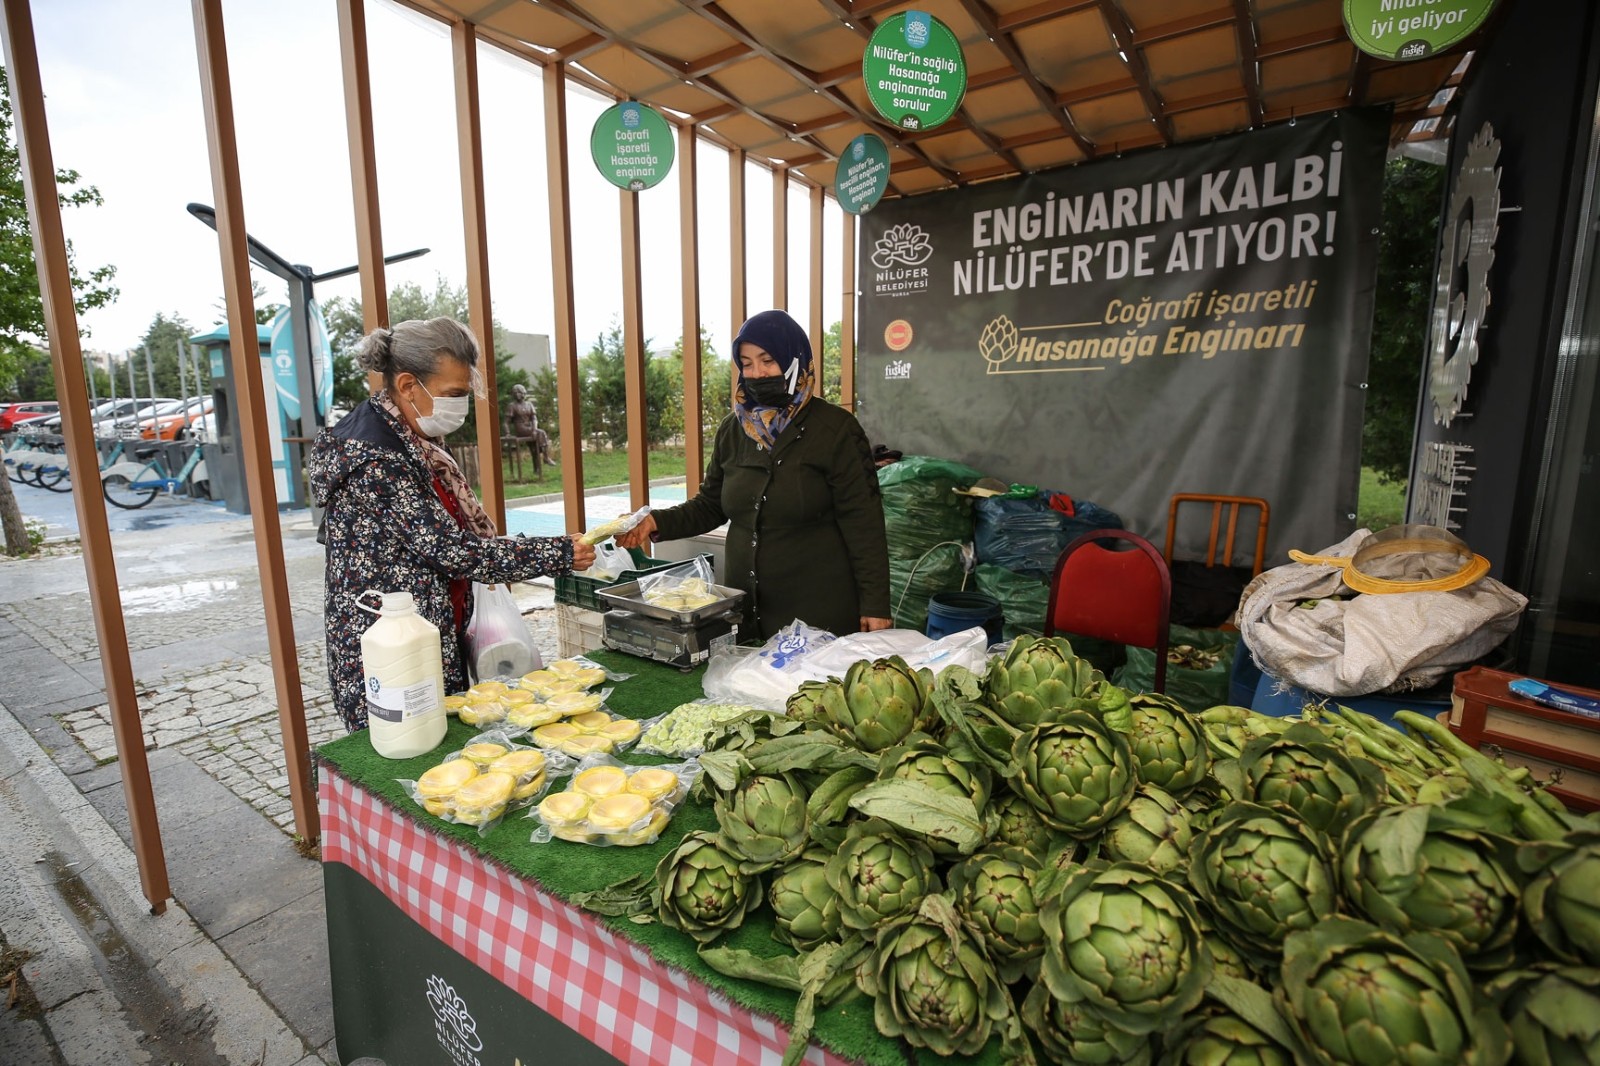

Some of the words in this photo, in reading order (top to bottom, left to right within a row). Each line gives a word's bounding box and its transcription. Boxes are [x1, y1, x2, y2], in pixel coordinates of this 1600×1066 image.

[1371, 16, 1394, 39] iyi
[1398, 8, 1468, 35] geliyor
[873, 45, 921, 65] Nilüfer'in
[922, 56, 957, 74] sağlığı
[888, 63, 940, 85] Hasanağa
[878, 79, 947, 100] enginarından
[892, 97, 931, 112] sorulur
[615, 129, 650, 142] Coğrafi
[616, 142, 650, 156] işaretli
[610, 154, 658, 167] Hasanağa
[615, 166, 655, 179] enginarı
[848, 175, 877, 196] Hasanağa
[851, 186, 876, 204] enginarı
[973, 178, 1185, 248] ENGİNARIN
[1199, 140, 1343, 216] KALBİ
[953, 235, 1156, 296] NİLÜFER'DE
[1165, 210, 1337, 273] ATIYOR!
[875, 267, 929, 282] NİLÜFER
[875, 278, 928, 292] BELEDİYESİ
[1105, 291, 1203, 328] Coğrafi
[1205, 280, 1318, 321] işaretli
[1015, 328, 1158, 364] Hasanağa
[1163, 320, 1306, 359] Enginarı
[437, 1032, 469, 1066] BELEDİY
